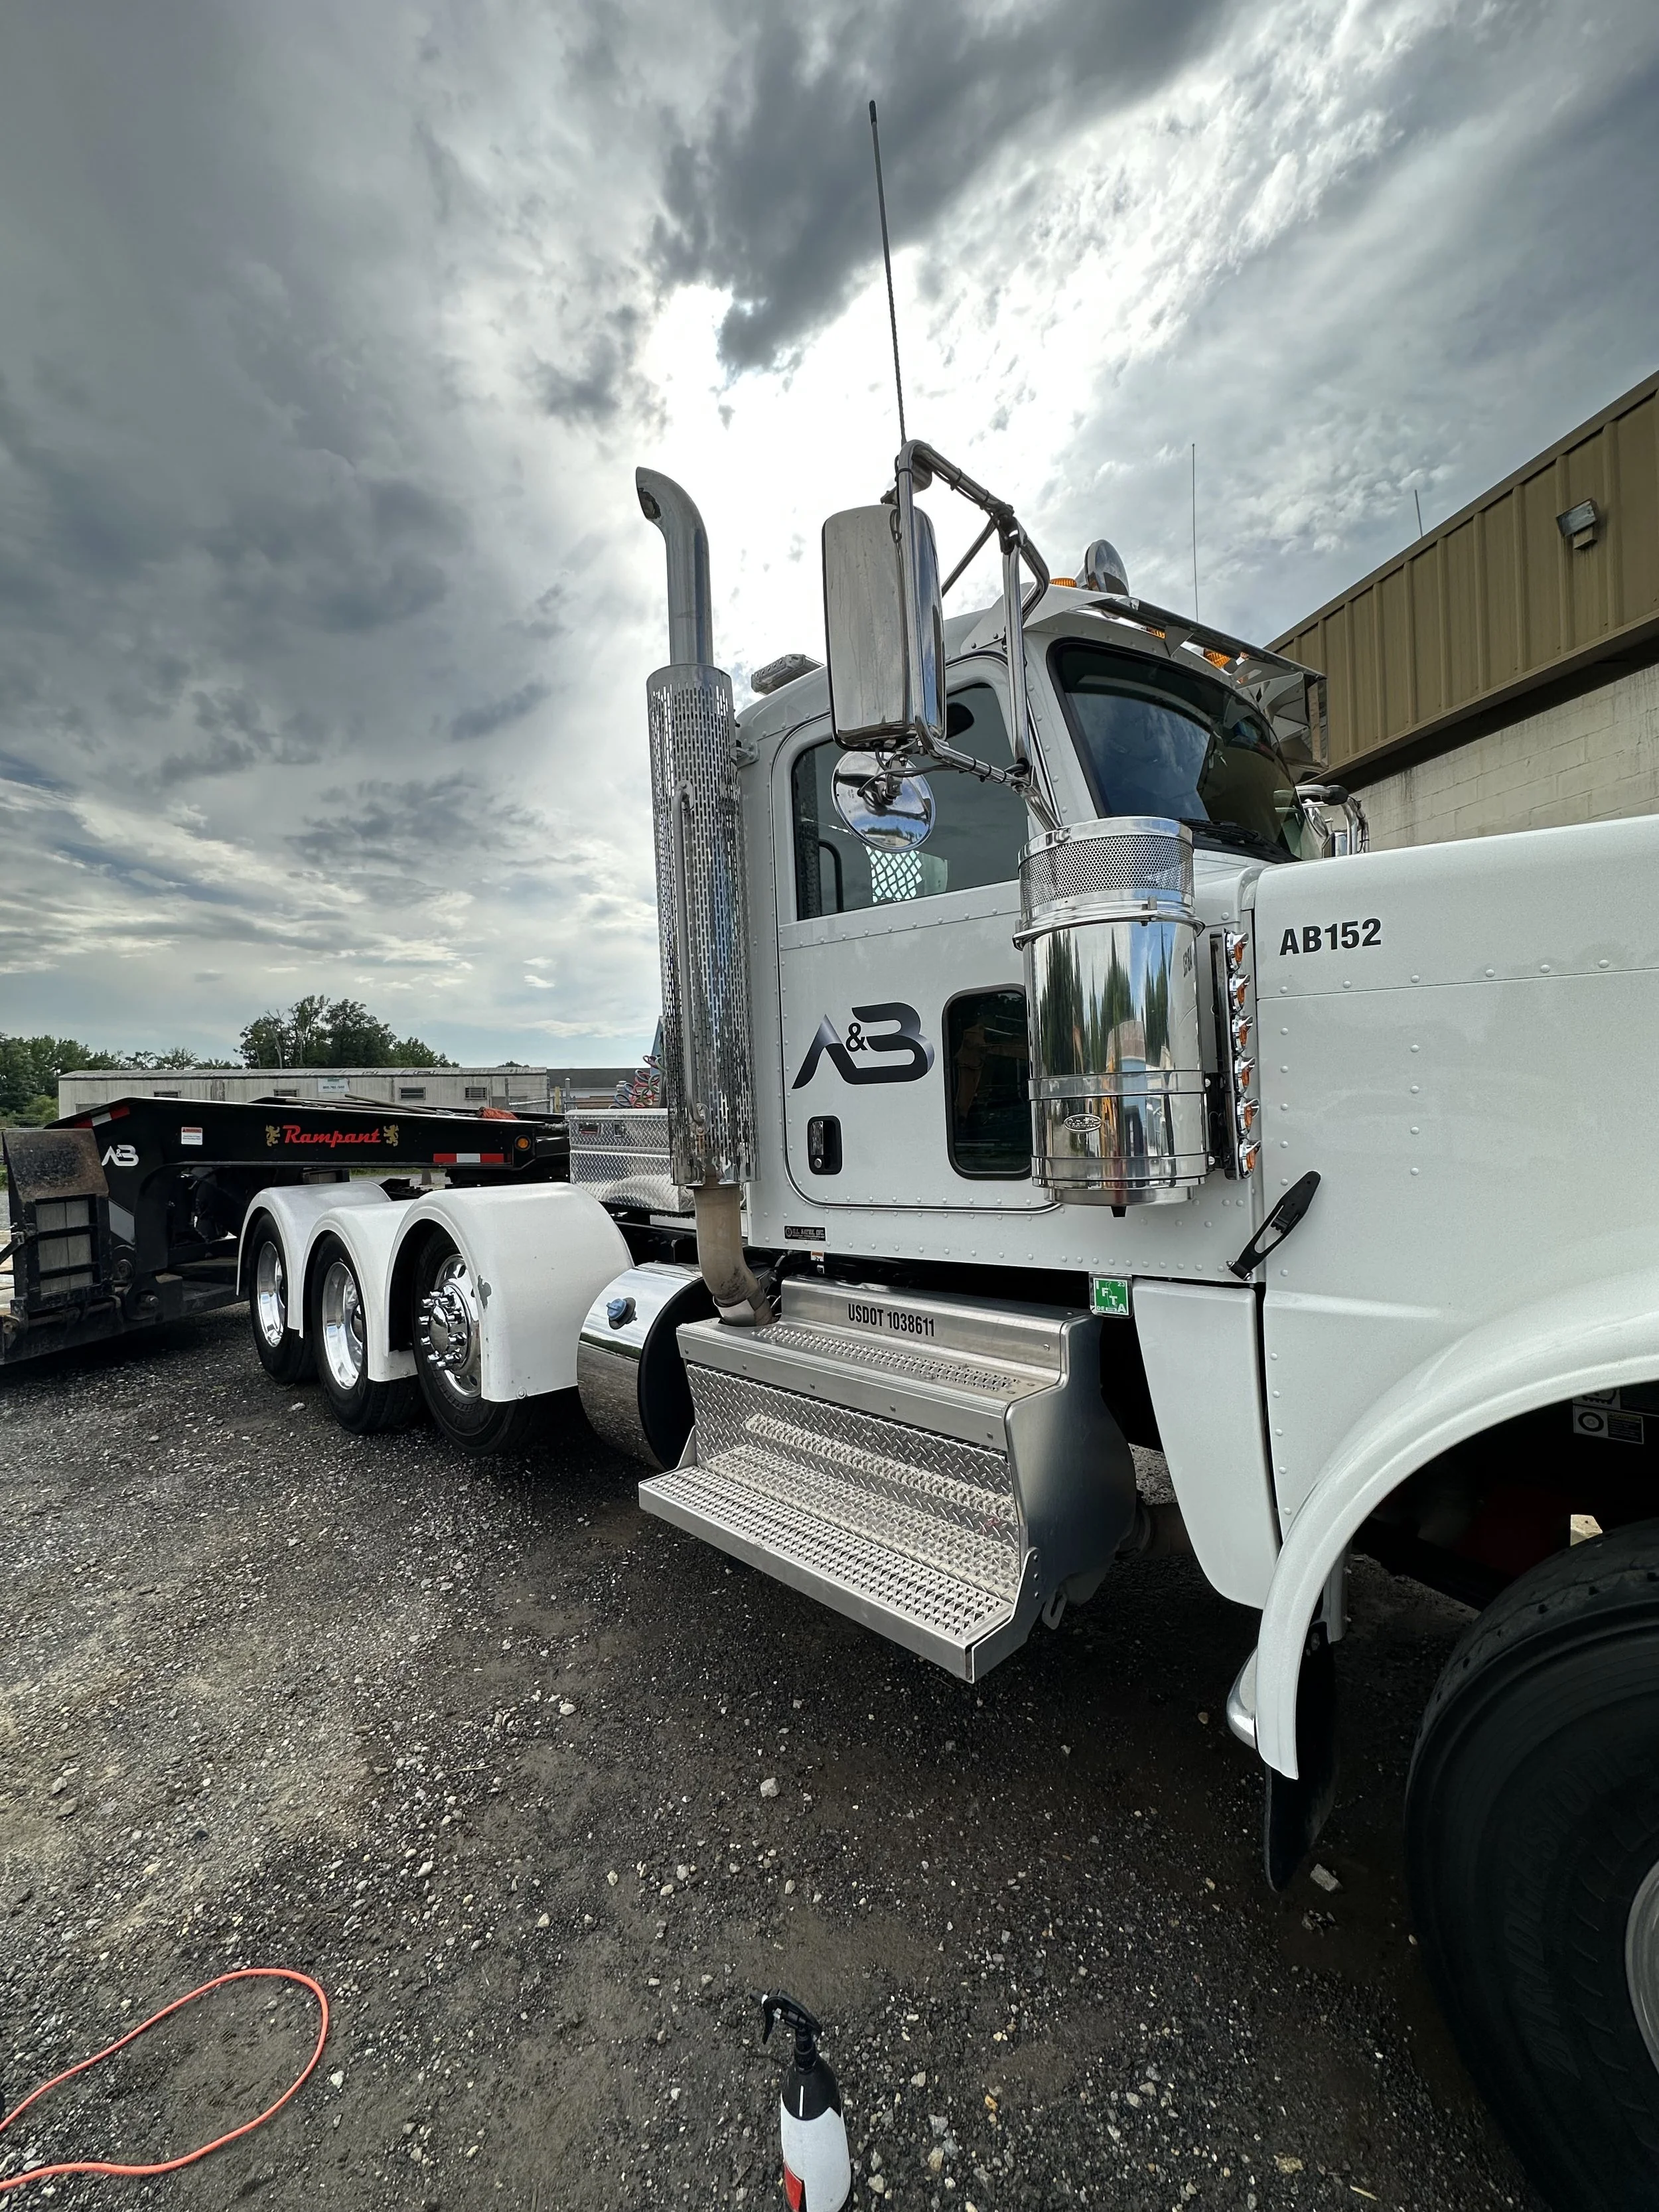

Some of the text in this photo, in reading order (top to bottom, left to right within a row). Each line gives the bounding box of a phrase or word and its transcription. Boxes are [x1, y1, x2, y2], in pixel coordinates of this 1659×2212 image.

[1279, 918, 1382, 956] AB152
[283, 1125, 382, 1147] Rampant
[848, 1303, 934, 1337] USDOT 1038611
